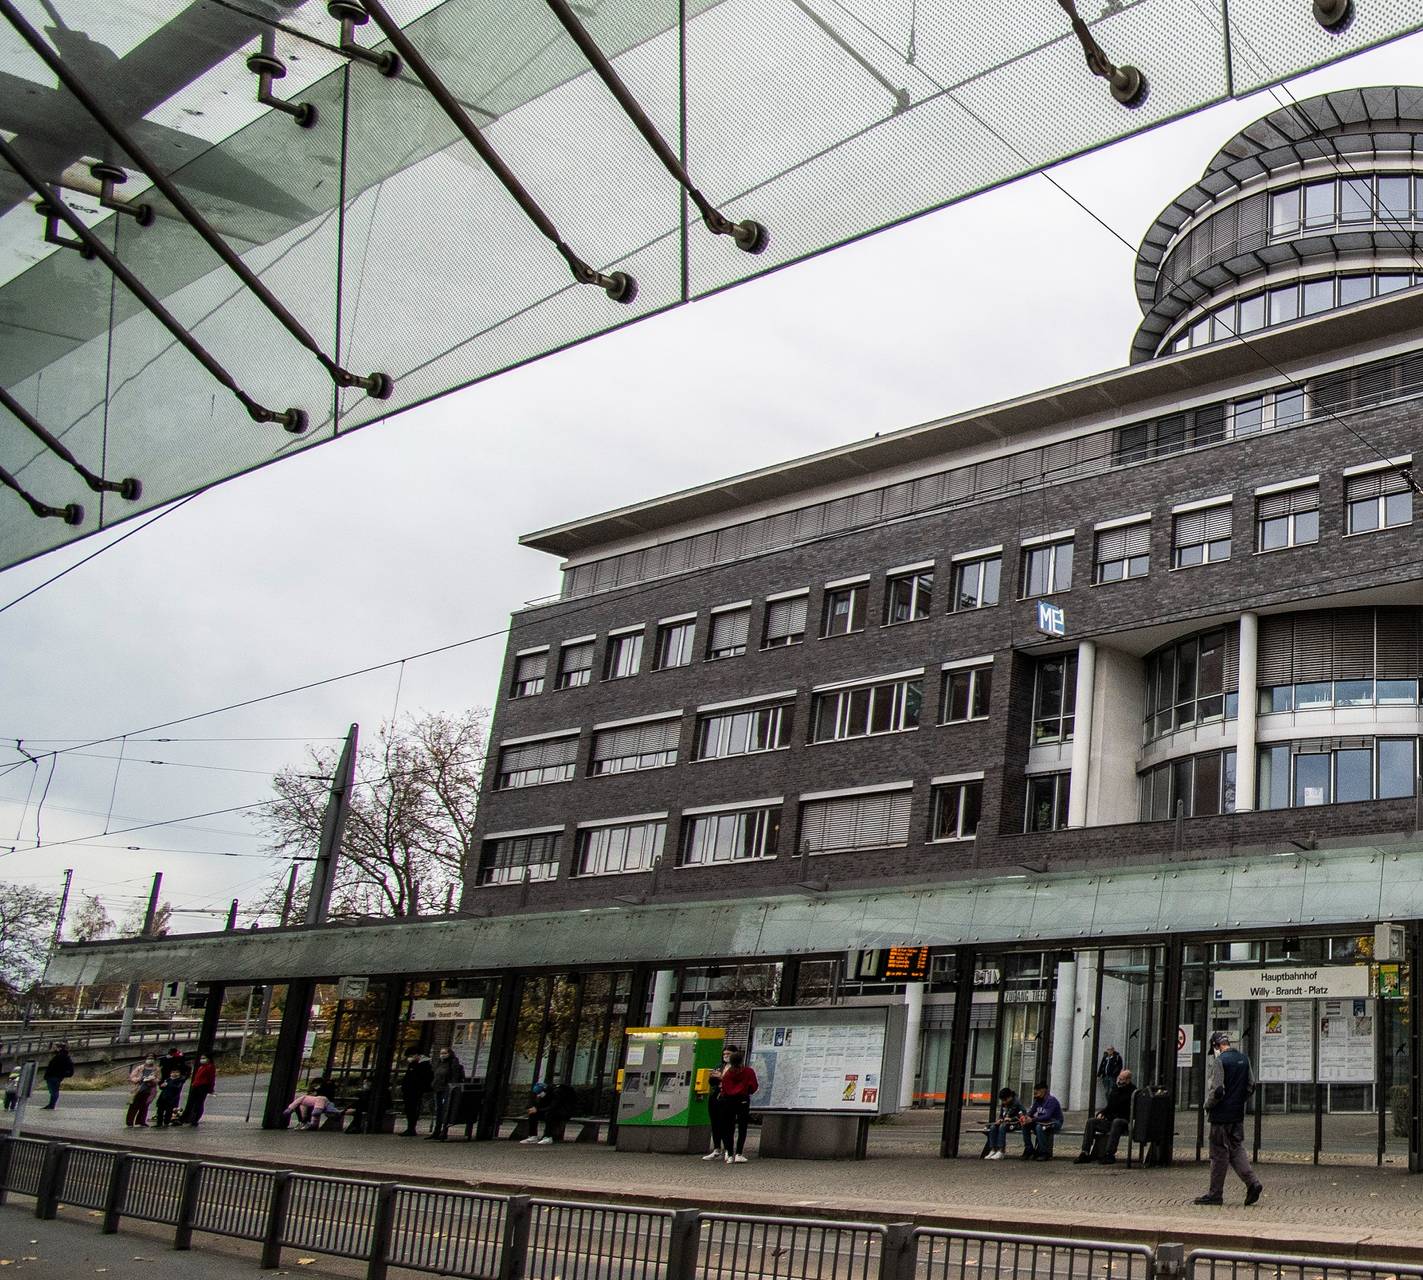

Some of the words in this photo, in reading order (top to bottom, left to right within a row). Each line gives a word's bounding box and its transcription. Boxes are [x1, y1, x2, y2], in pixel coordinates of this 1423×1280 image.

[865, 948, 874, 971] 1
[1260, 971, 1318, 983] Hauptbahnhof
[167, 981, 179, 997] 1
[1249, 987, 1270, 998] Willy
[1275, 986, 1303, 996] Brandt
[1308, 985, 1329, 995] Platz
